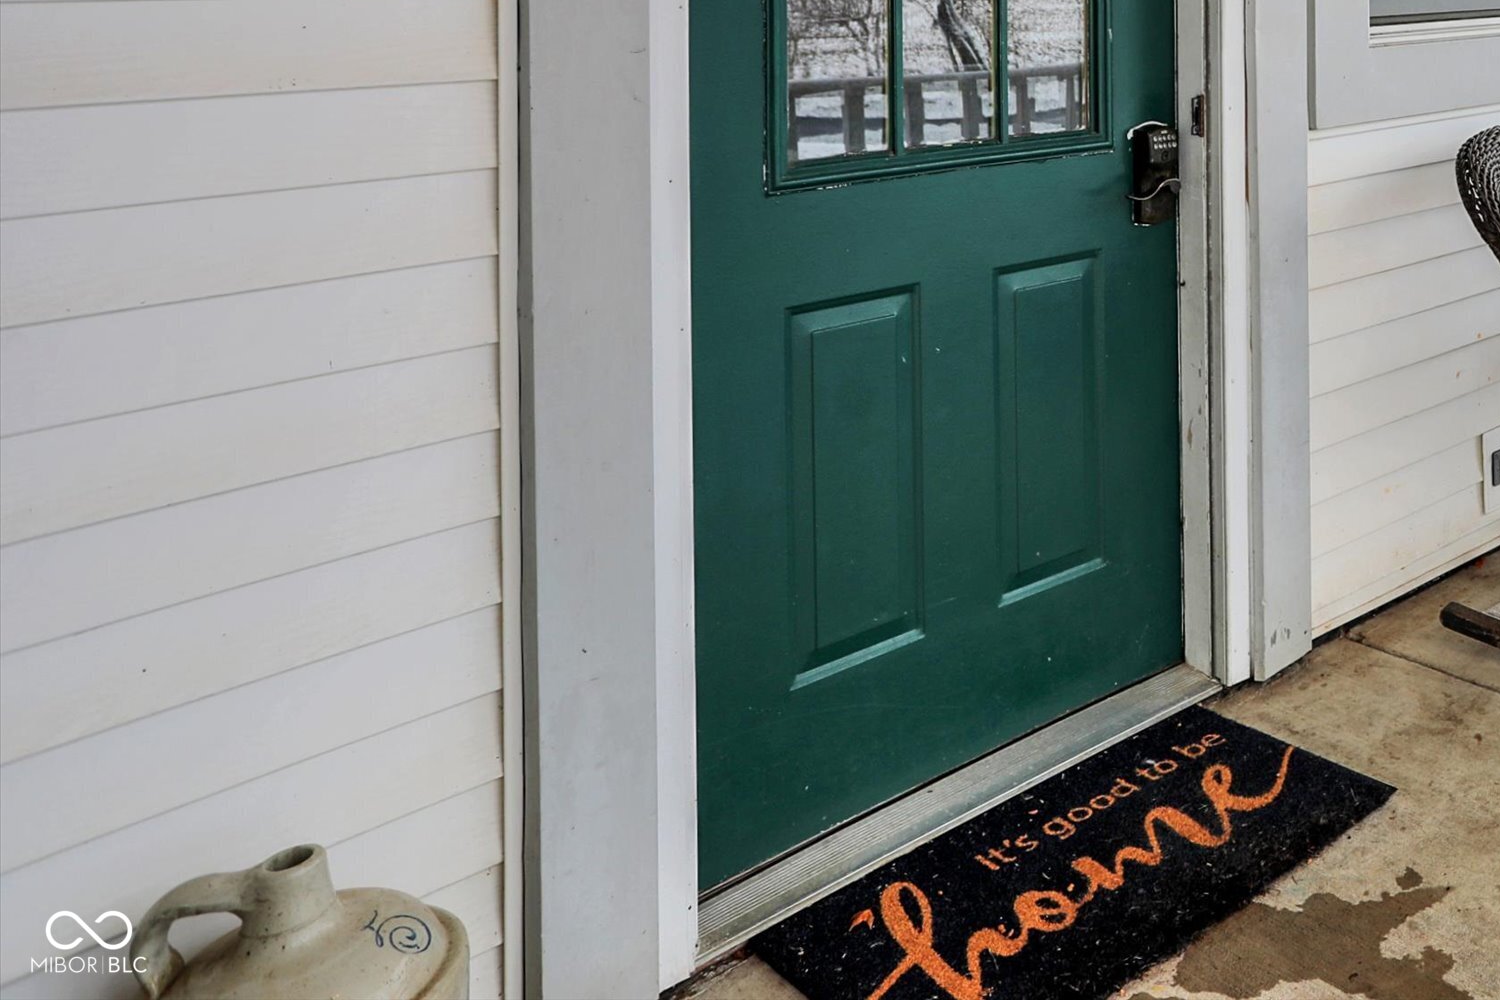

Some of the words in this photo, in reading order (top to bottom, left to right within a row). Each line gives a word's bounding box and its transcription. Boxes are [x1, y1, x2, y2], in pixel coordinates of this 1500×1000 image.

[868, 746, 1293, 1000] home
[975, 834, 1039, 870] It's
[1042, 778, 1141, 840] good
[1135, 759, 1178, 781] to
[1171, 733, 1227, 759] be
